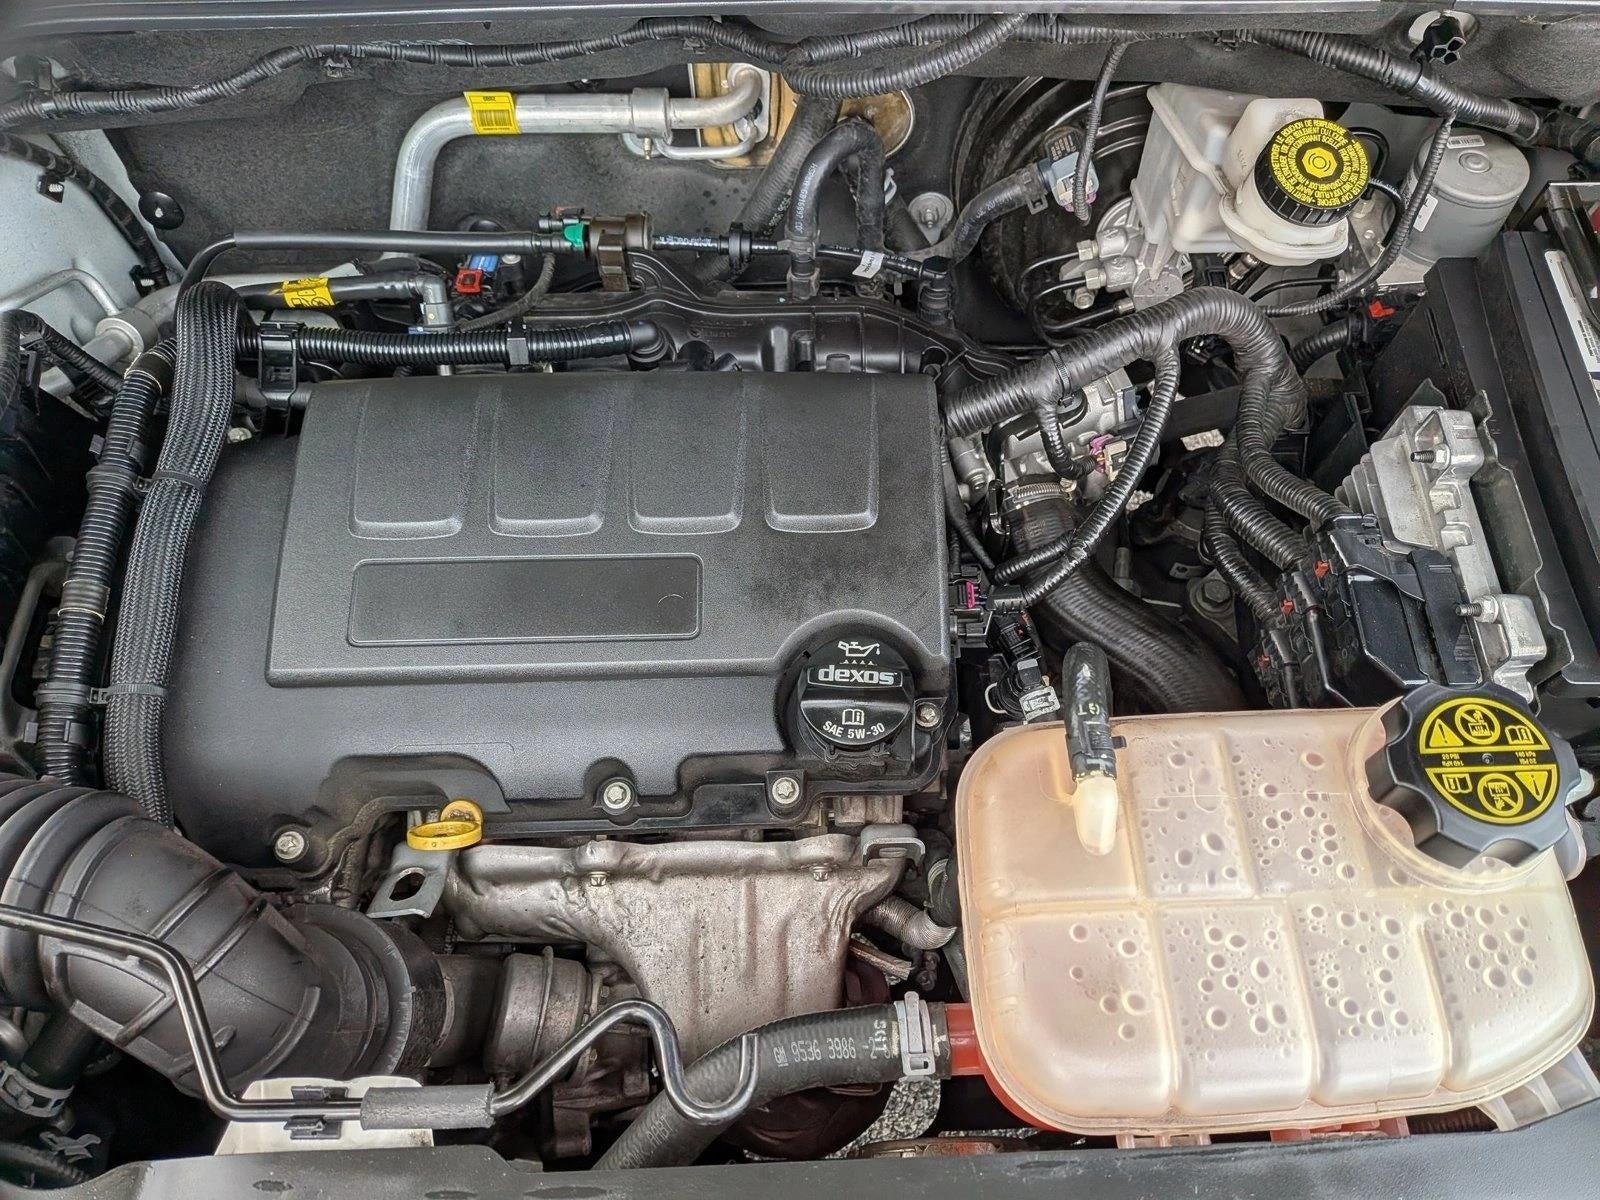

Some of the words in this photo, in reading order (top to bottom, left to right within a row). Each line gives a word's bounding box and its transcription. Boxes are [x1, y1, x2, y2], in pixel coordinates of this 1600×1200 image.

[1274, 134, 1284, 144] LE
[1316, 196, 1341, 205] BEFORE
[1338, 191, 1354, 202] CAP
[818, 665, 896, 685] dexos
[823, 721, 844, 737] SAE
[847, 723, 885, 739] 5W-30
[773, 1046, 788, 1066] GM
[791, 1039, 821, 1062] 9536
[827, 1037, 856, 1059] 3986
